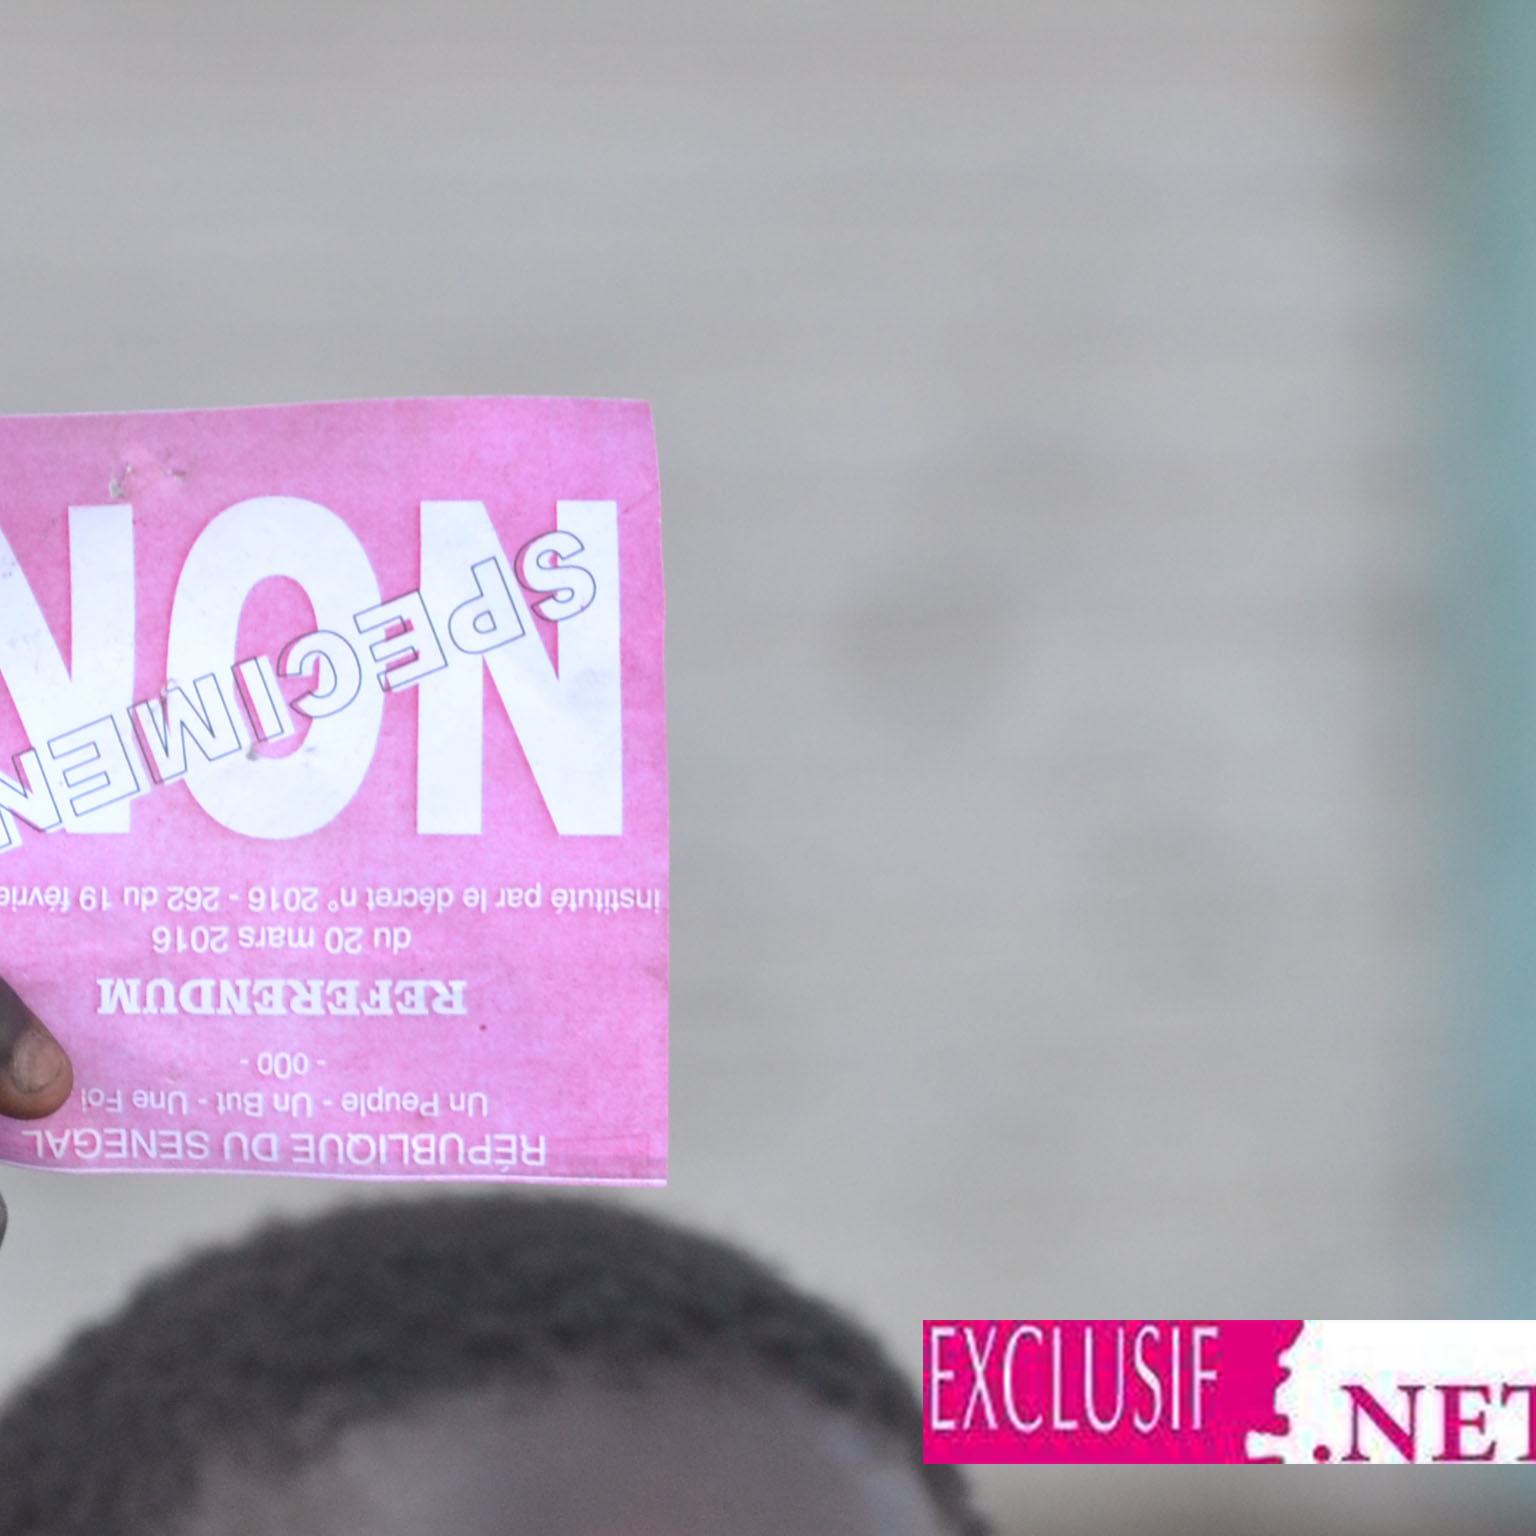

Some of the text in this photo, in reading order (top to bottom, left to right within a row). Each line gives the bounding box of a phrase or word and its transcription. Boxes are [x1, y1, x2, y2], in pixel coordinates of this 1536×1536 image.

[79, 886, 112, 912] 19
[123, 886, 159, 912] du
[167, 886, 220, 912] 262
[248, 886, 319, 912] 2016
[366, 886, 455, 914] décret
[462, 887, 488, 914] le
[495, 882, 542, 909] par
[551, 887, 661, 914] instituté
[151, 925, 412, 954] du 20 mars 2016
[96, 977, 467, 1016] REFERENDUM
[80, 1088, 123, 1113] Foi
[132, 1089, 188, 1115] Une
[216, 1091, 264, 1118] But
[273, 1092, 314, 1118] Un
[341, 1086, 440, 1118] Peuple
[449, 1092, 488, 1118] Un
[21, 1128, 547, 1172] RÉPUBLIQUE DU SENEGAL
